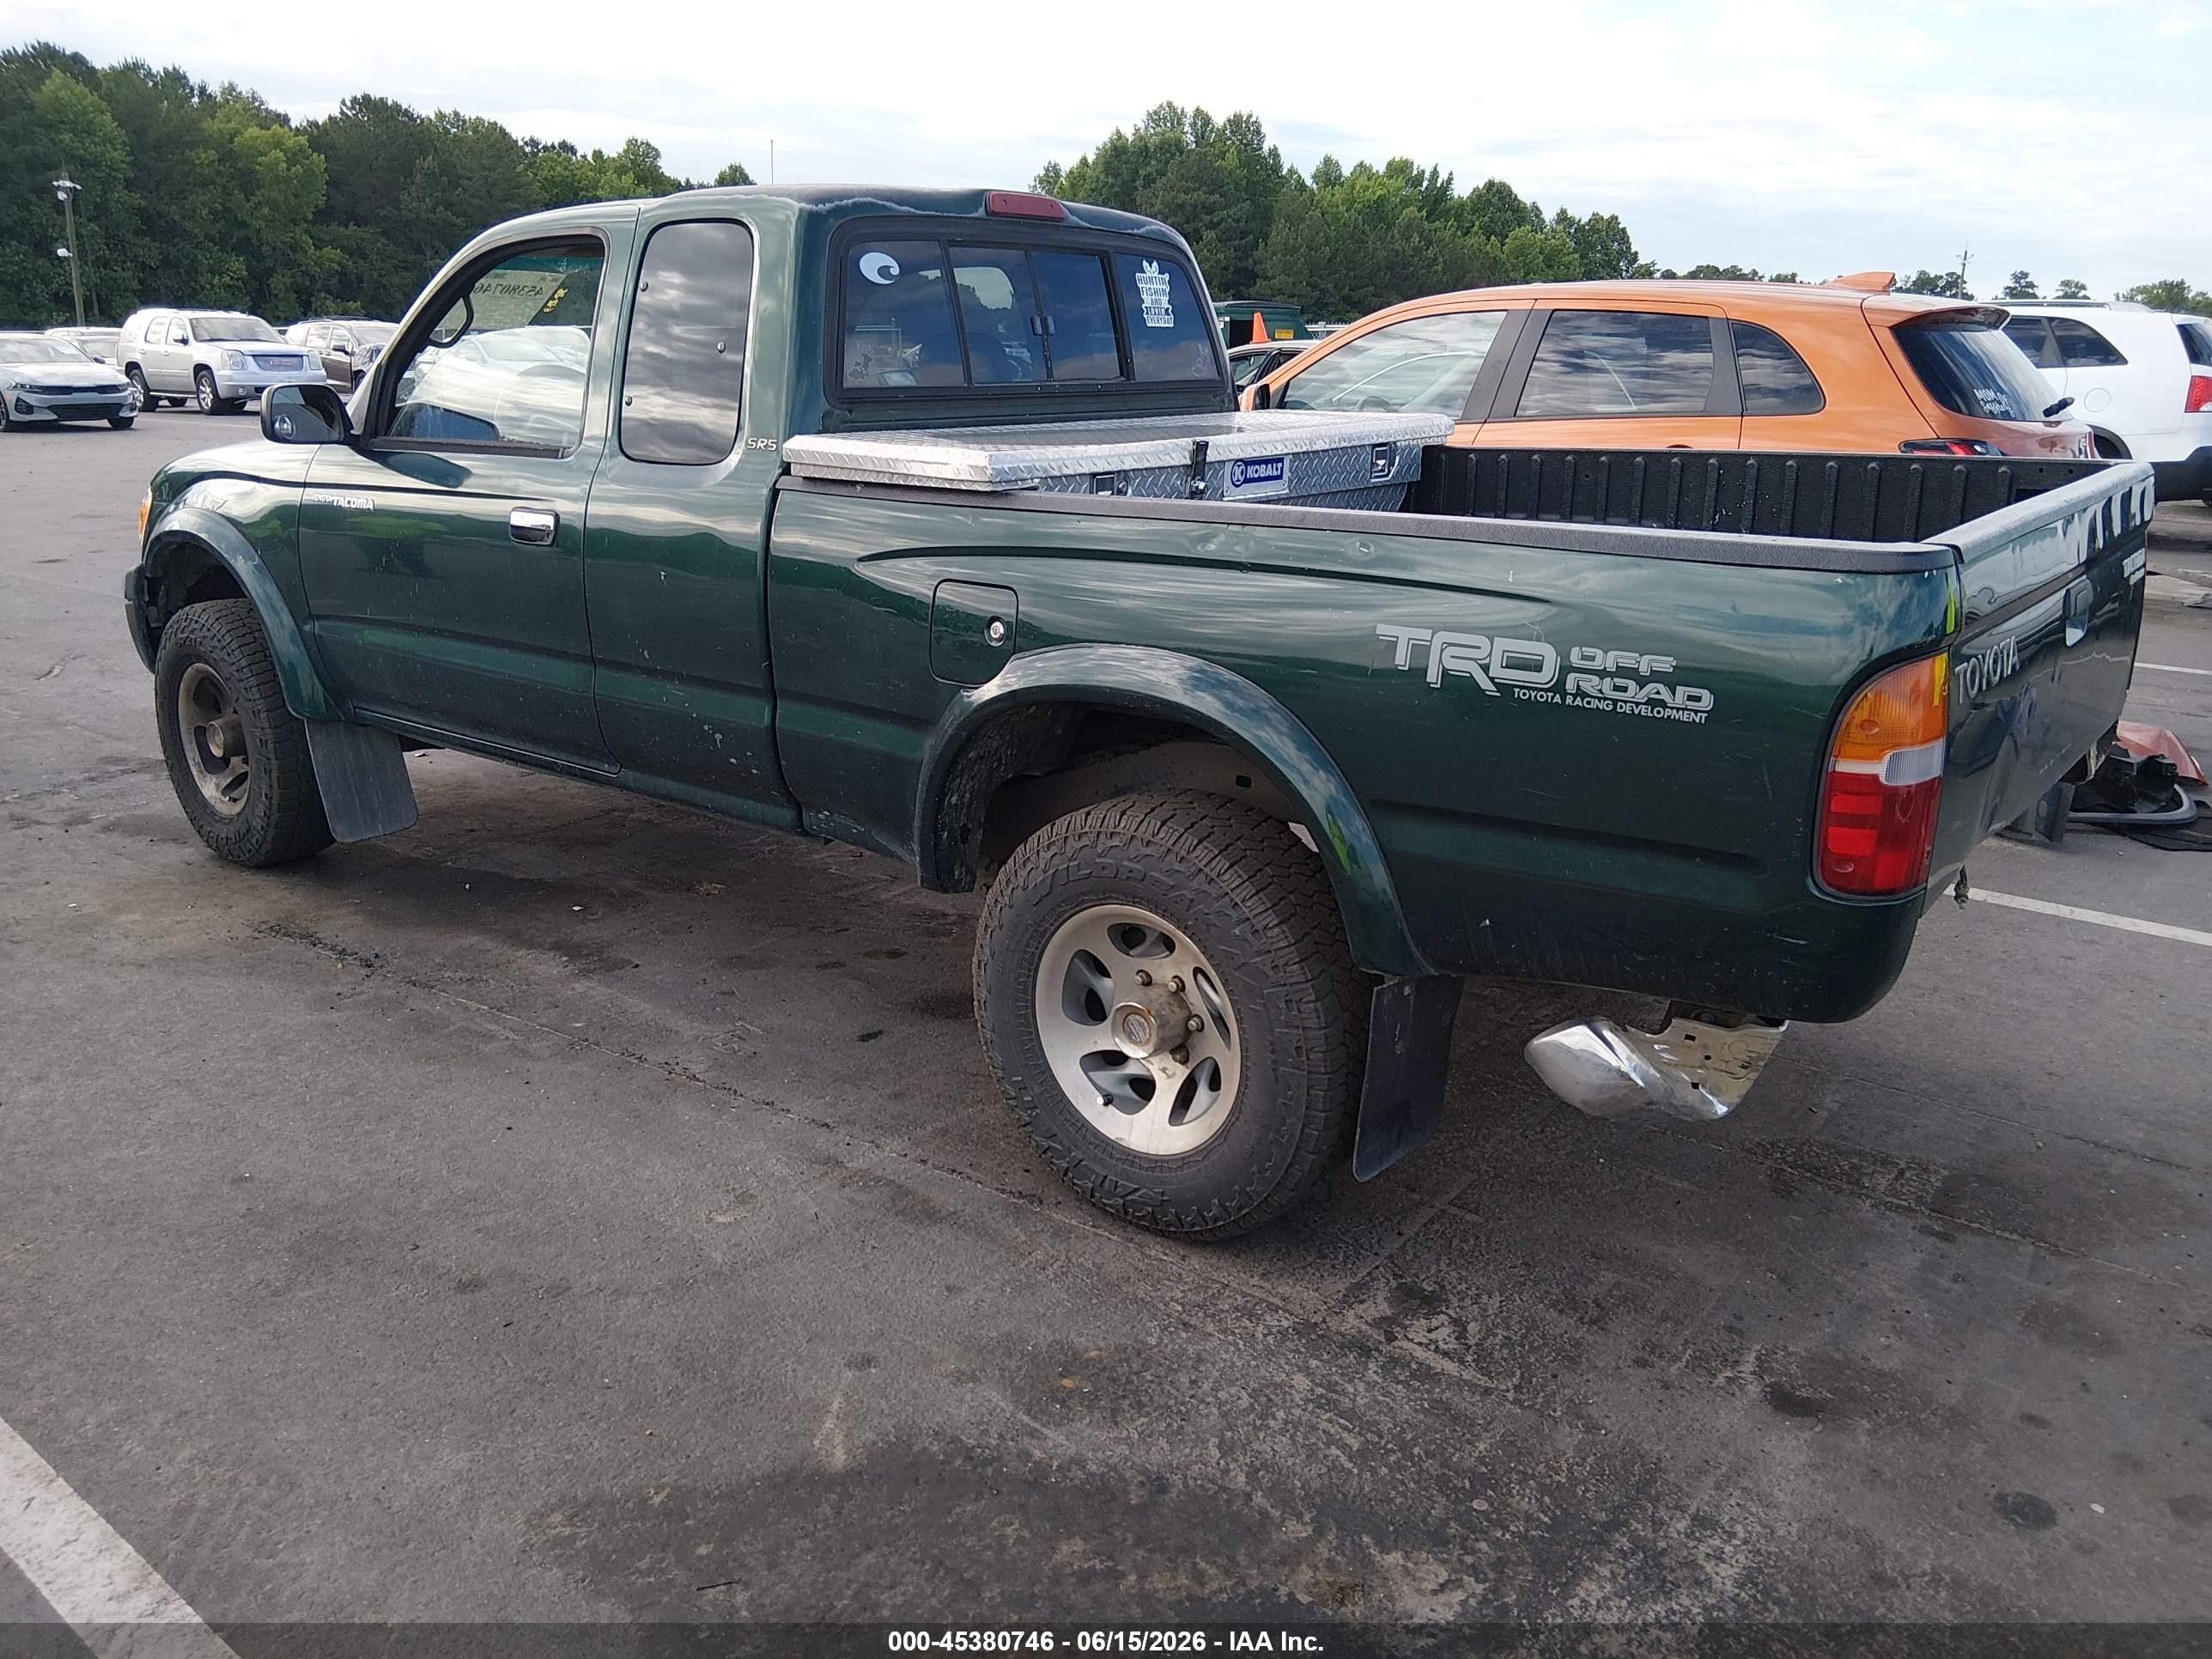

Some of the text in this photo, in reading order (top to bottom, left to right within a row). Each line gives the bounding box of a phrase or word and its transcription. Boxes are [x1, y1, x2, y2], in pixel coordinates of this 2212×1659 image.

[1150, 297, 1163, 307] AND
[1146, 315, 1173, 325] EVERYDAY
[1973, 388, 1996, 403] MOM
[747, 438, 777, 451] SR5
[1247, 463, 1283, 478] KOBALT
[331, 496, 376, 510] TACOMA
[1375, 623, 1677, 696] TRD OFF
[1954, 635, 2019, 705] TOYOTA
[1565, 672, 1714, 712] ROAD
[1513, 688, 1708, 724] TOYOTA RACING DEVELOPMENT
